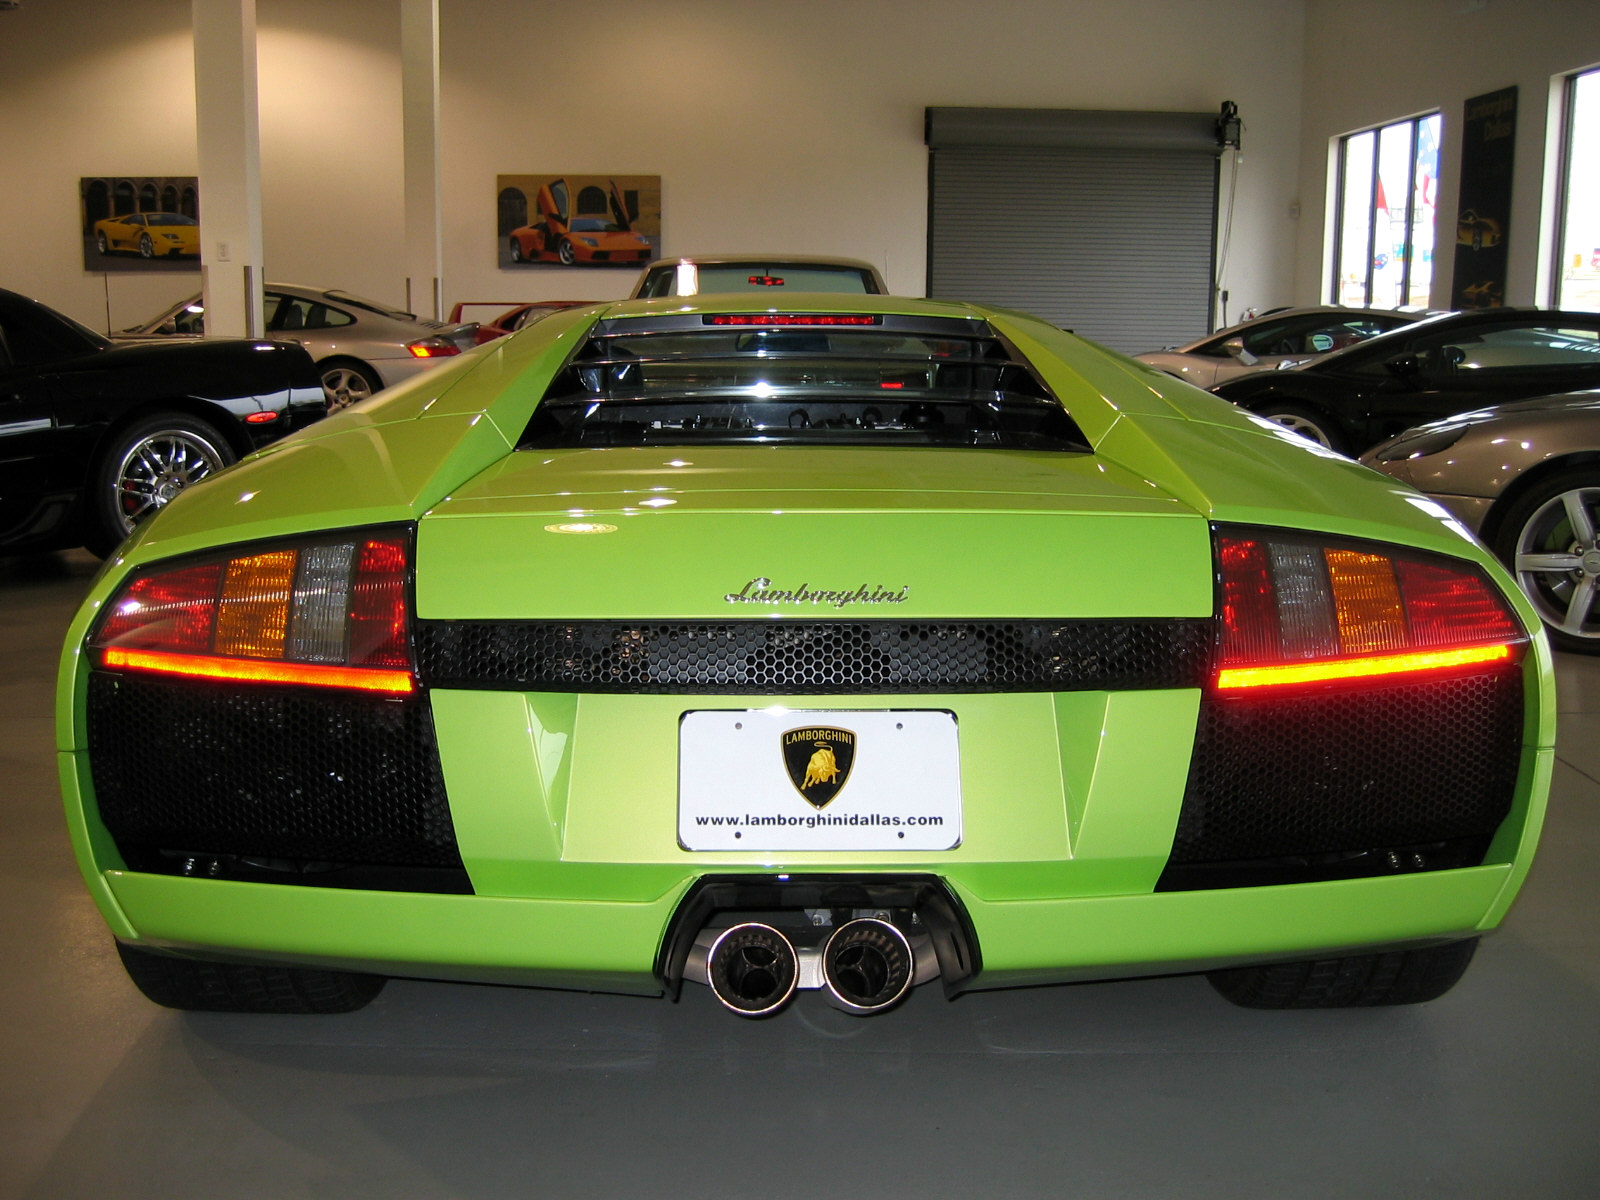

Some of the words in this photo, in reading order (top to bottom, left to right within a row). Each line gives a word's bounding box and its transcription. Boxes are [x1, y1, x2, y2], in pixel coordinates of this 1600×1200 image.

[724, 577, 909, 609] Lamborghini
[786, 730, 852, 745] LAMBORGHINI
[695, 813, 944, 828] www.lamborghinidallas.com
